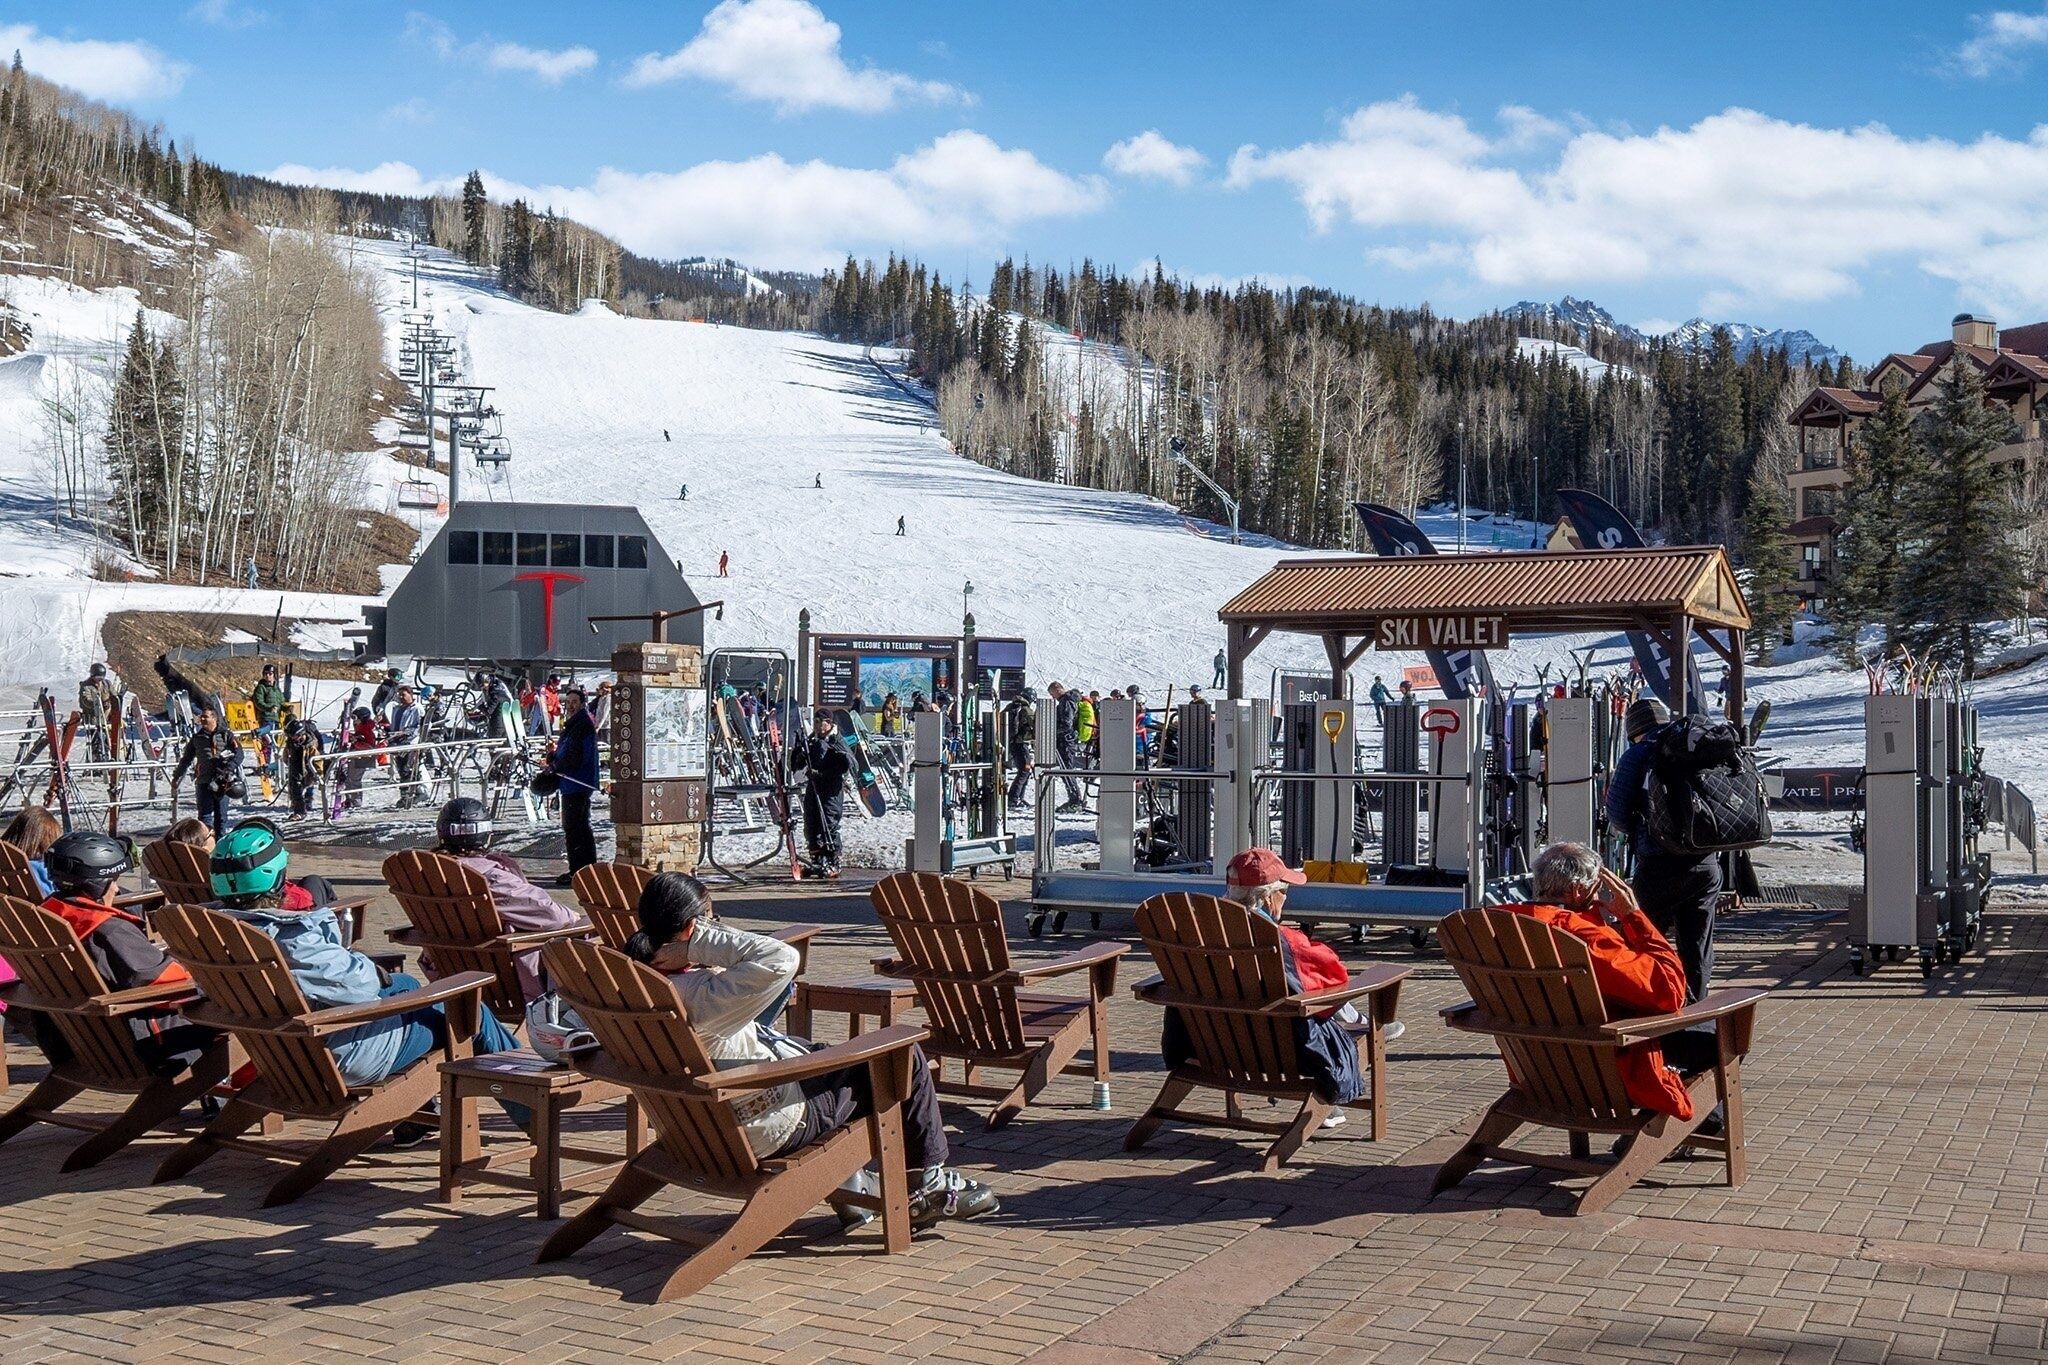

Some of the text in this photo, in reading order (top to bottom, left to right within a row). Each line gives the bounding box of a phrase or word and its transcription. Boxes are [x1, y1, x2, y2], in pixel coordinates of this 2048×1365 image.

[1381, 617, 1502, 646] SKI VALET
[852, 641, 923, 650] WELCOME TO TELLURIDE
[99, 862, 127, 876] SMITH
